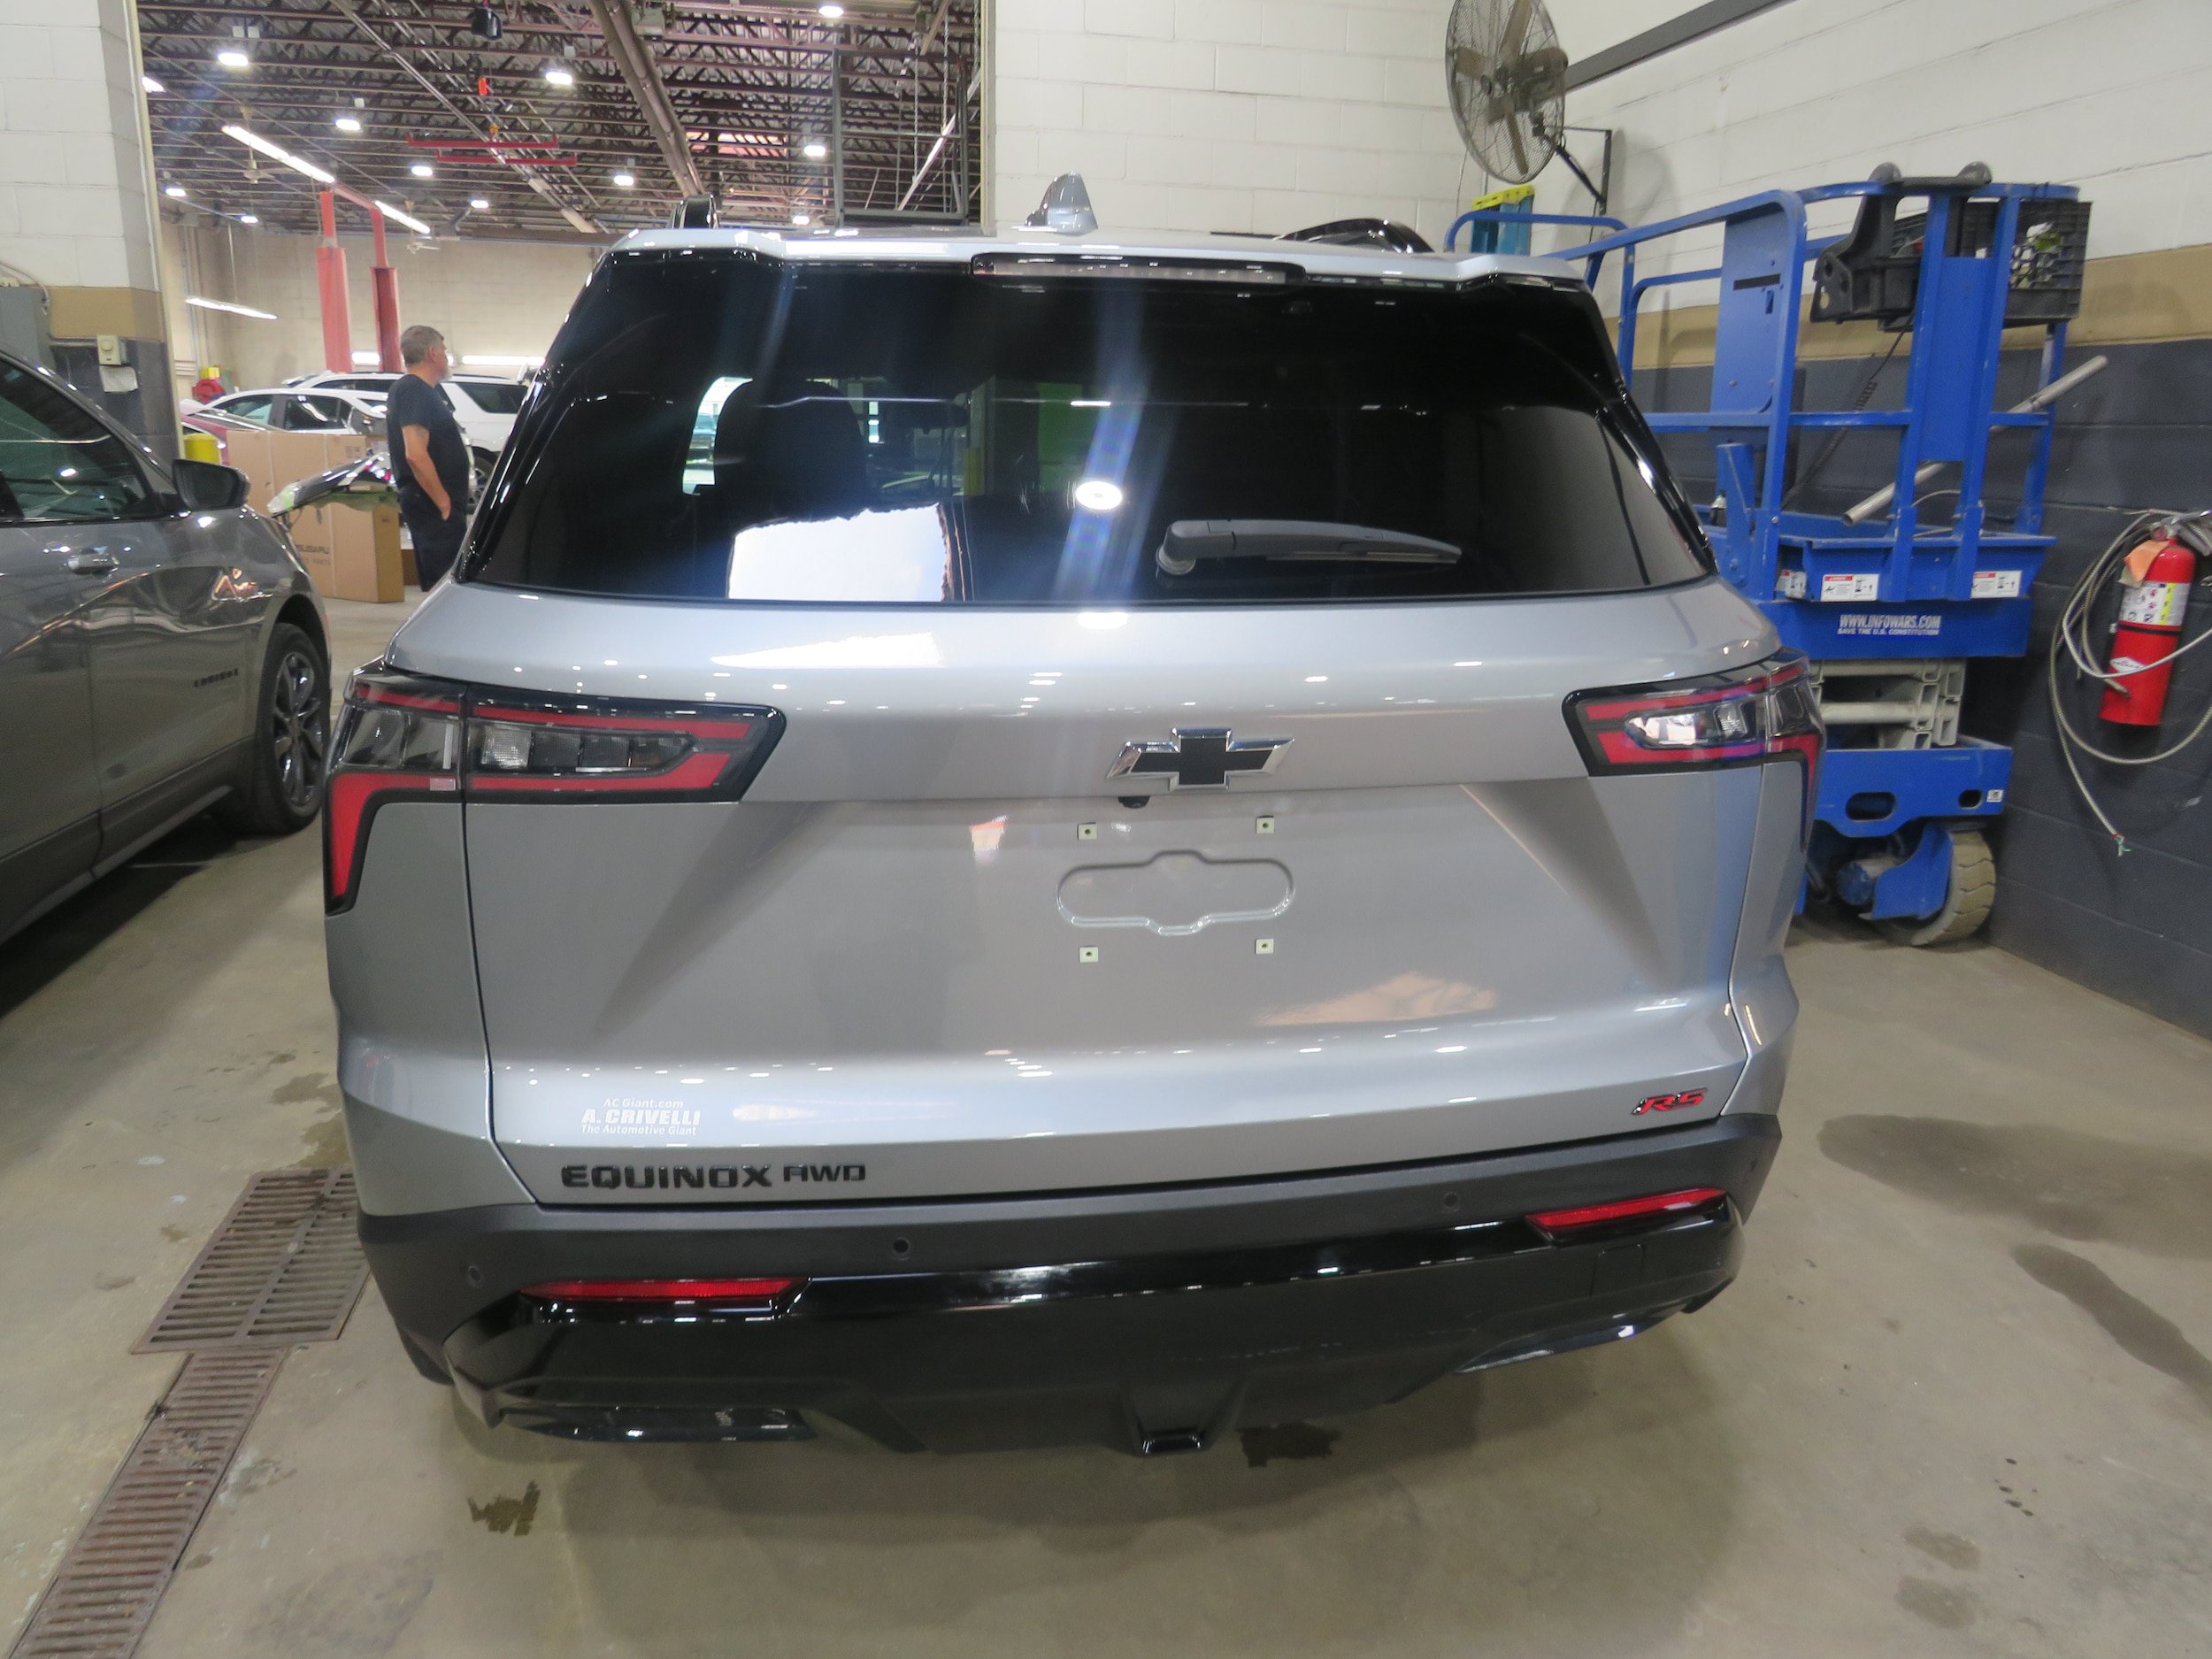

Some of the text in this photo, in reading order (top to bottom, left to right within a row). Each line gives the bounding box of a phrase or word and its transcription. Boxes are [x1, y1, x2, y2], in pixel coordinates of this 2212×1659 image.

[1839, 614, 1942, 629] WWW.INFOWARS.COM
[603, 1097, 684, 1109] AC Giant.com
[1631, 1087, 1708, 1115] RS
[580, 1108, 702, 1125] A. CRIVELLI
[581, 1124, 696, 1136] The Automotive Giant
[561, 1164, 866, 1190] EQUINOX AWD
